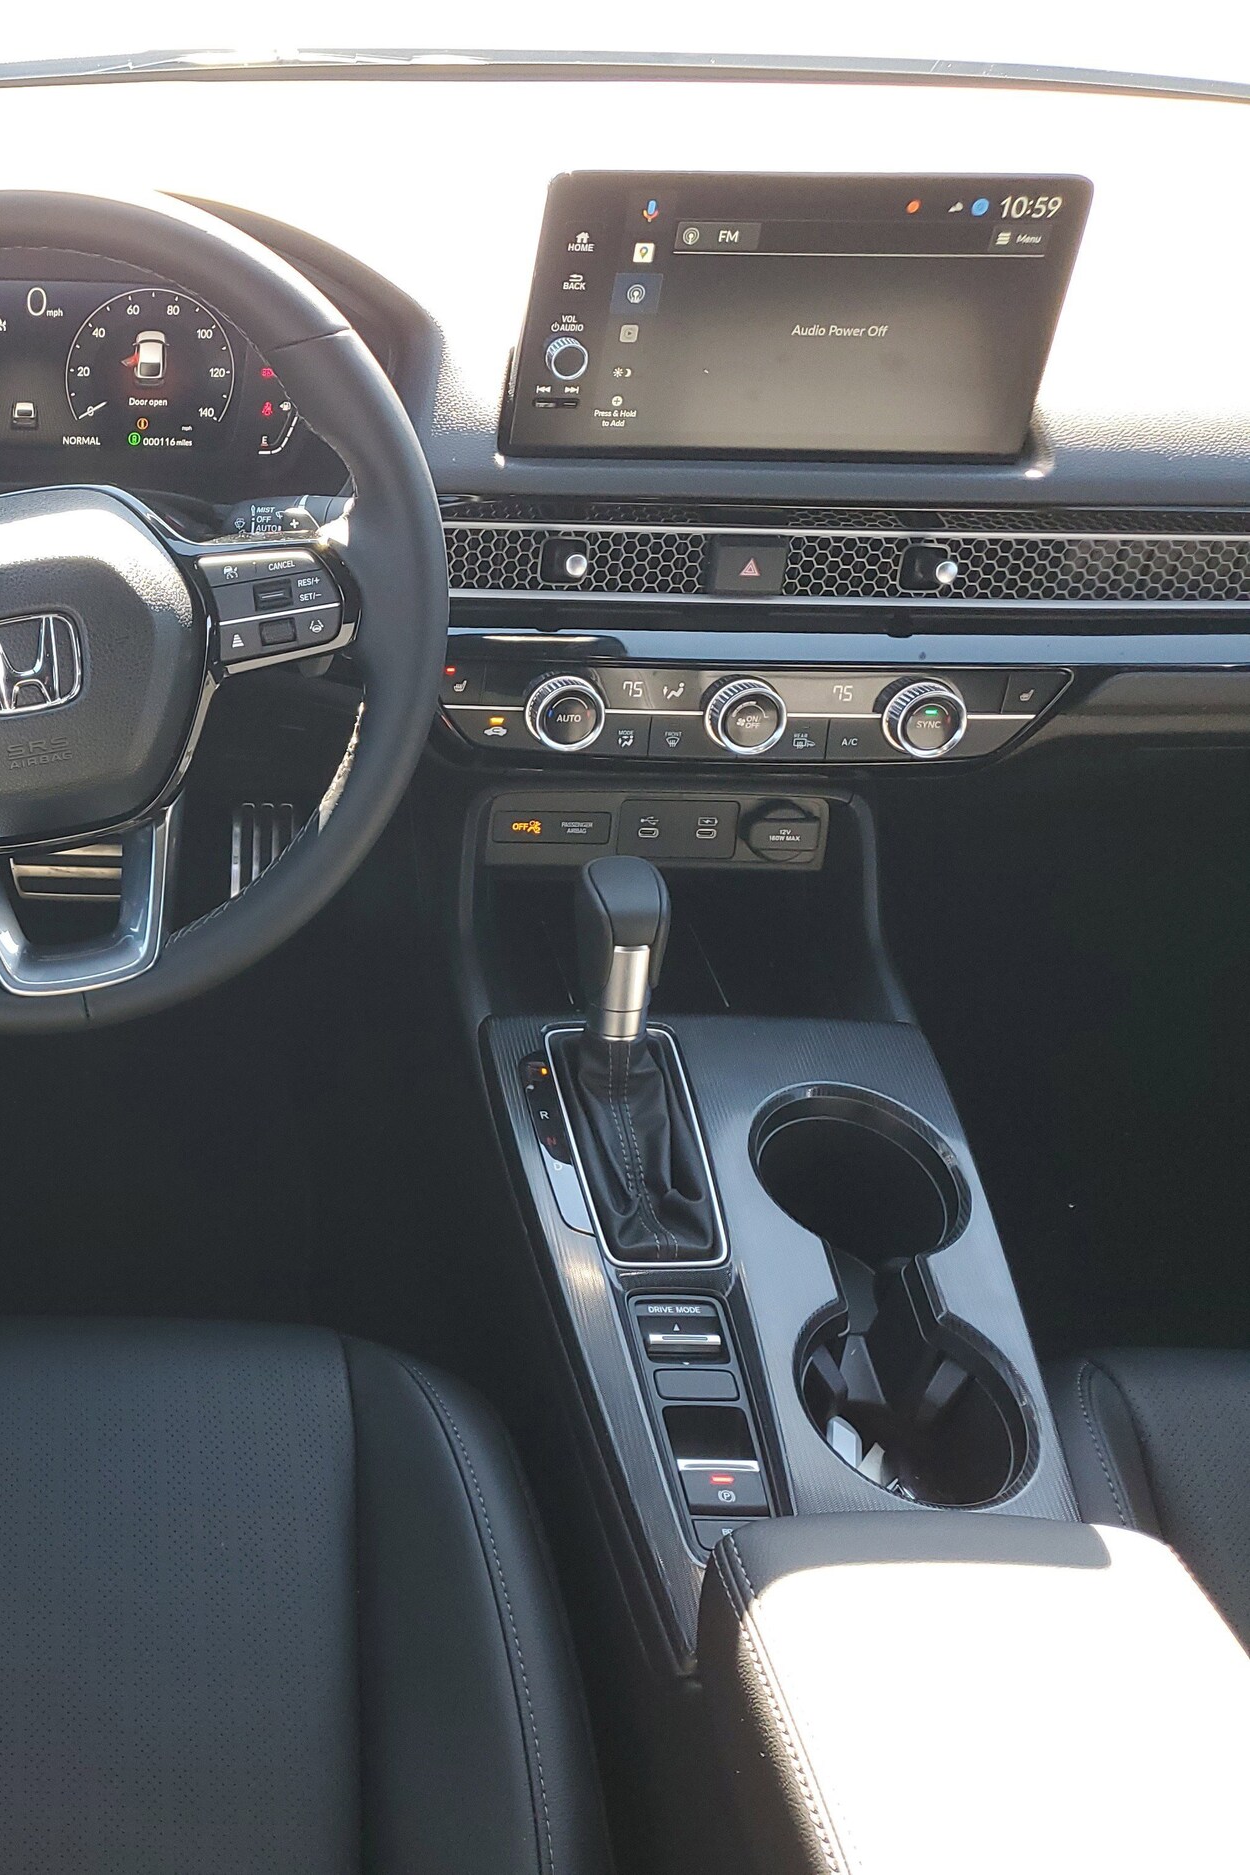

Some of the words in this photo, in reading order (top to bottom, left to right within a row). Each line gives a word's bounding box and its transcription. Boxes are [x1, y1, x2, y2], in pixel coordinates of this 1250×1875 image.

[1000, 195, 1063, 219] 10:59
[718, 229, 740, 243] FM
[1015, 233, 1042, 244] Menu
[567, 243, 595, 252] HOME
[562, 282, 586, 291] BACK
[27, 287, 47, 316] 0
[46, 308, 63, 318] mph
[126, 305, 140, 315] 60
[166, 305, 180, 315] 80
[561, 315, 577, 323] VOL
[92, 327, 106, 338] 40
[559, 323, 584, 332] AUDIO
[791, 324, 826, 336] Audio
[828, 325, 866, 337] Power
[867, 325, 889, 337] Off
[196, 328, 213, 339] 100
[77, 366, 91, 377] 20
[209, 367, 226, 378] 120
[128, 397, 147, 406] Door
[148, 399, 168, 408] open
[198, 407, 215, 418] 140
[594, 409, 612, 417] Press
[620, 409, 637, 418] Hold
[601, 419, 610, 427] to
[610, 419, 626, 427] Add
[62, 436, 101, 446] NORMAL
[142, 437, 175, 447] 000116
[175, 439, 193, 447] miles
[261, 435, 268, 444] E
[256, 506, 276, 514] MIST
[256, 515, 272, 523] OFF
[268, 560, 296, 571] CANCEL
[622, 681, 644, 698] 75
[832, 685, 854, 702] 75
[556, 714, 582, 723] AUTO
[915, 720, 942, 730] SYNC
[6, 736, 70, 756] SRS
[841, 737, 858, 747] A/C
[9, 752, 74, 770] AIRBAG
[511, 821, 529, 831] OFF
[539, 1110, 550, 1120] R
[546, 1135, 557, 1146] N
[553, 1162, 563, 1171] D
[648, 1305, 674, 1314] DRIVE
[676, 1305, 701, 1314] MODE
